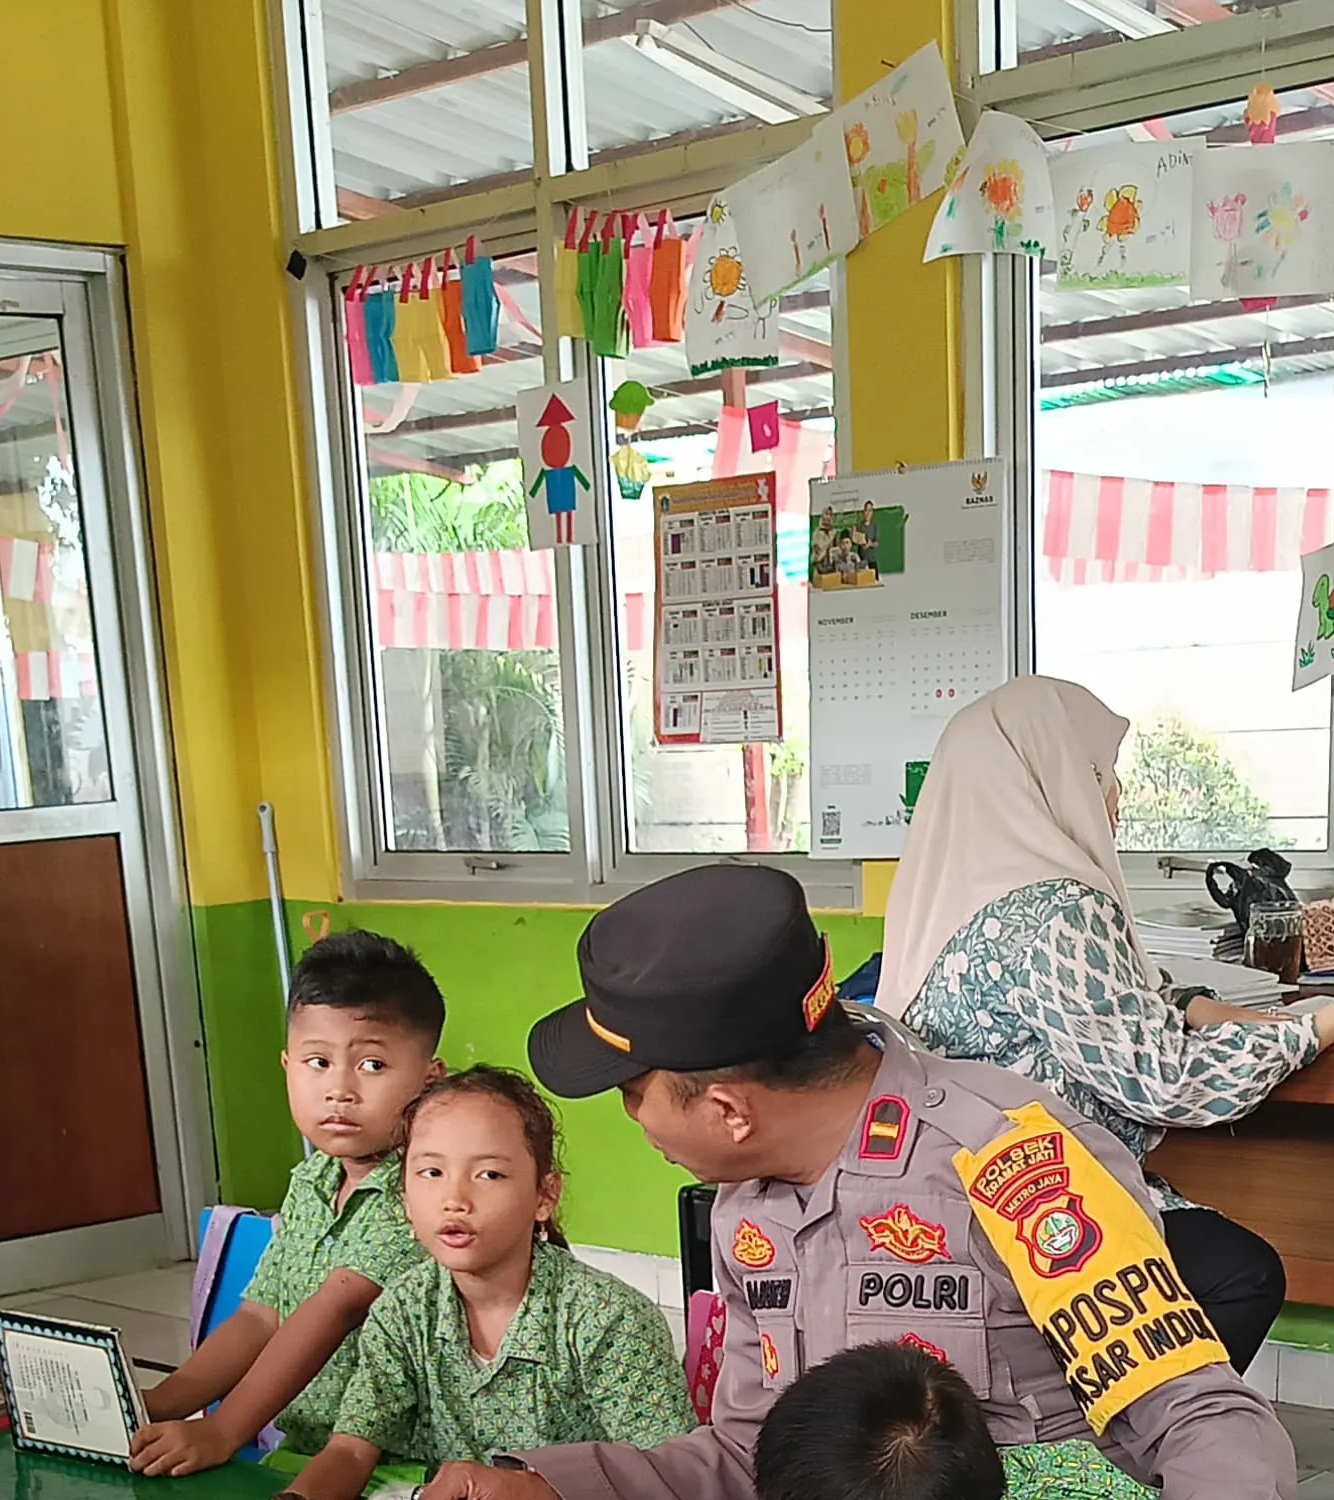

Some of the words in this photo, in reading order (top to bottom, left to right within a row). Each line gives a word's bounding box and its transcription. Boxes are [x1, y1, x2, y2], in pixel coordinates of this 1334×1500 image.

[976, 1136, 1054, 1192] POLSEK
[984, 1159, 1028, 1200] KRAMAT
[1028, 1149, 1055, 1165] JATI
[1004, 1183, 1037, 1215] METRO
[1037, 1173, 1063, 1189] JAYA
[858, 1271, 970, 1312] POLRI
